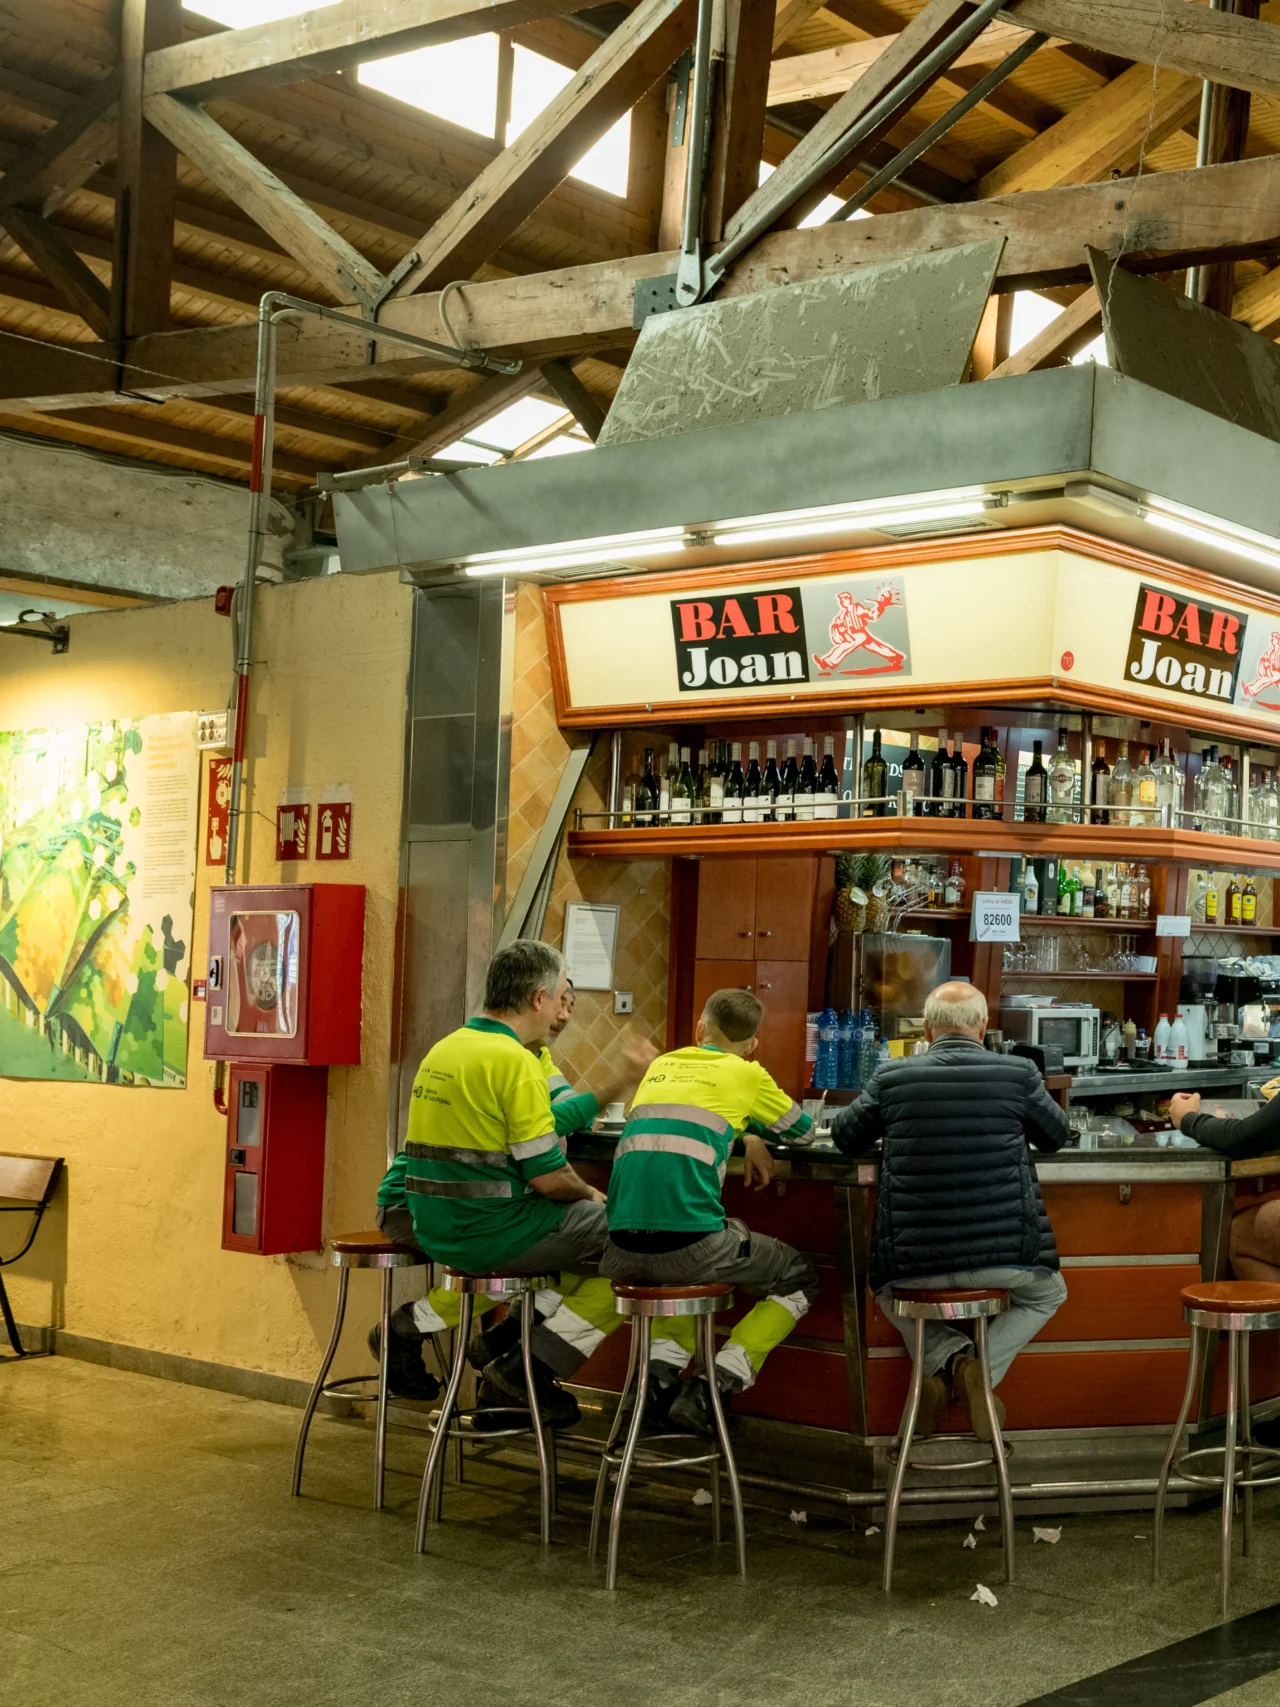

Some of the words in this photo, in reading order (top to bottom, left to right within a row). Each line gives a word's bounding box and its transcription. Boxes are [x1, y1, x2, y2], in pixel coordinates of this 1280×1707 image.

[676, 594, 800, 642] BAR
[1138, 589, 1240, 655] BAR
[682, 647, 806, 687] Joan
[1130, 638, 1233, 699] Joan
[983, 913, 1012, 926] 82600
